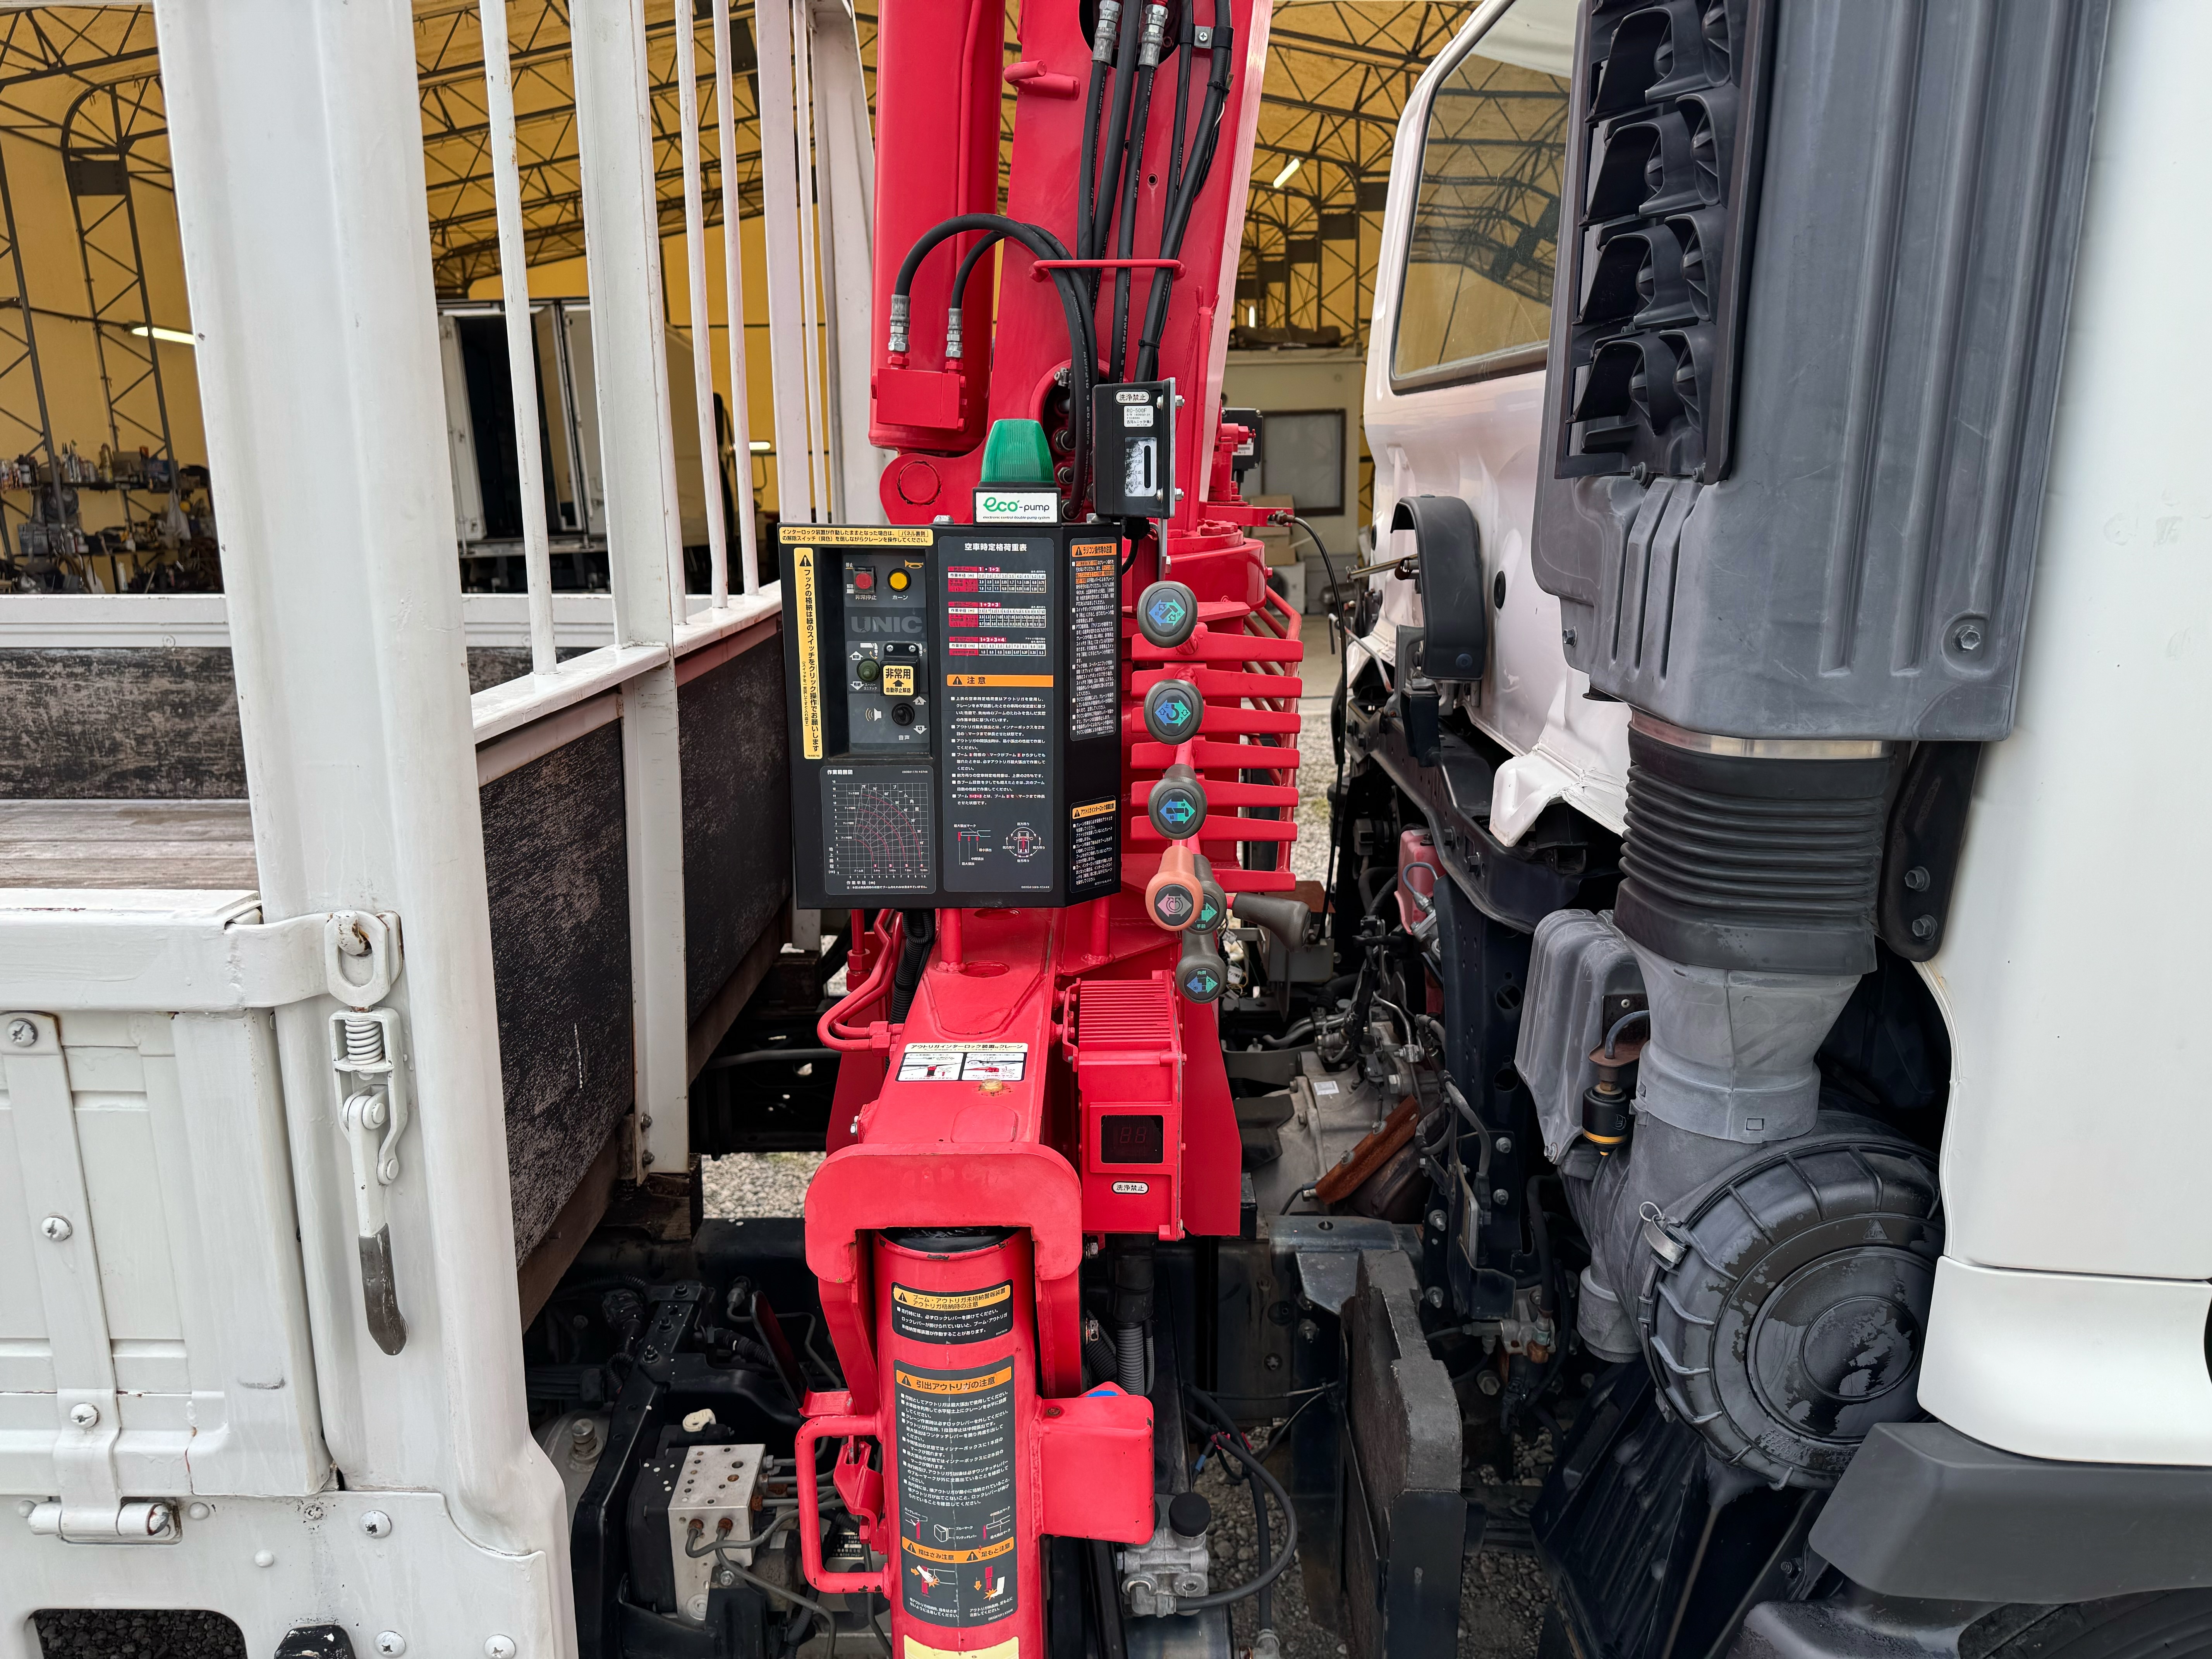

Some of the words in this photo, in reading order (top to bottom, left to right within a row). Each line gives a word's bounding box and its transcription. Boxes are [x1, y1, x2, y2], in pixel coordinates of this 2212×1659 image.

[964, 543, 1027, 552] 空車時定格荷重表
[851, 616, 922, 634] UNIC
[886, 668, 911, 679] 非常用
[913, 1301, 978, 1310] アウトリガ格納時の注意
[916, 1376, 995, 1391] 引出アウトリガの注意
[918, 1549, 954, 1561] 指はさみ注意
[981, 1542, 1010, 1558] 足もと注意
